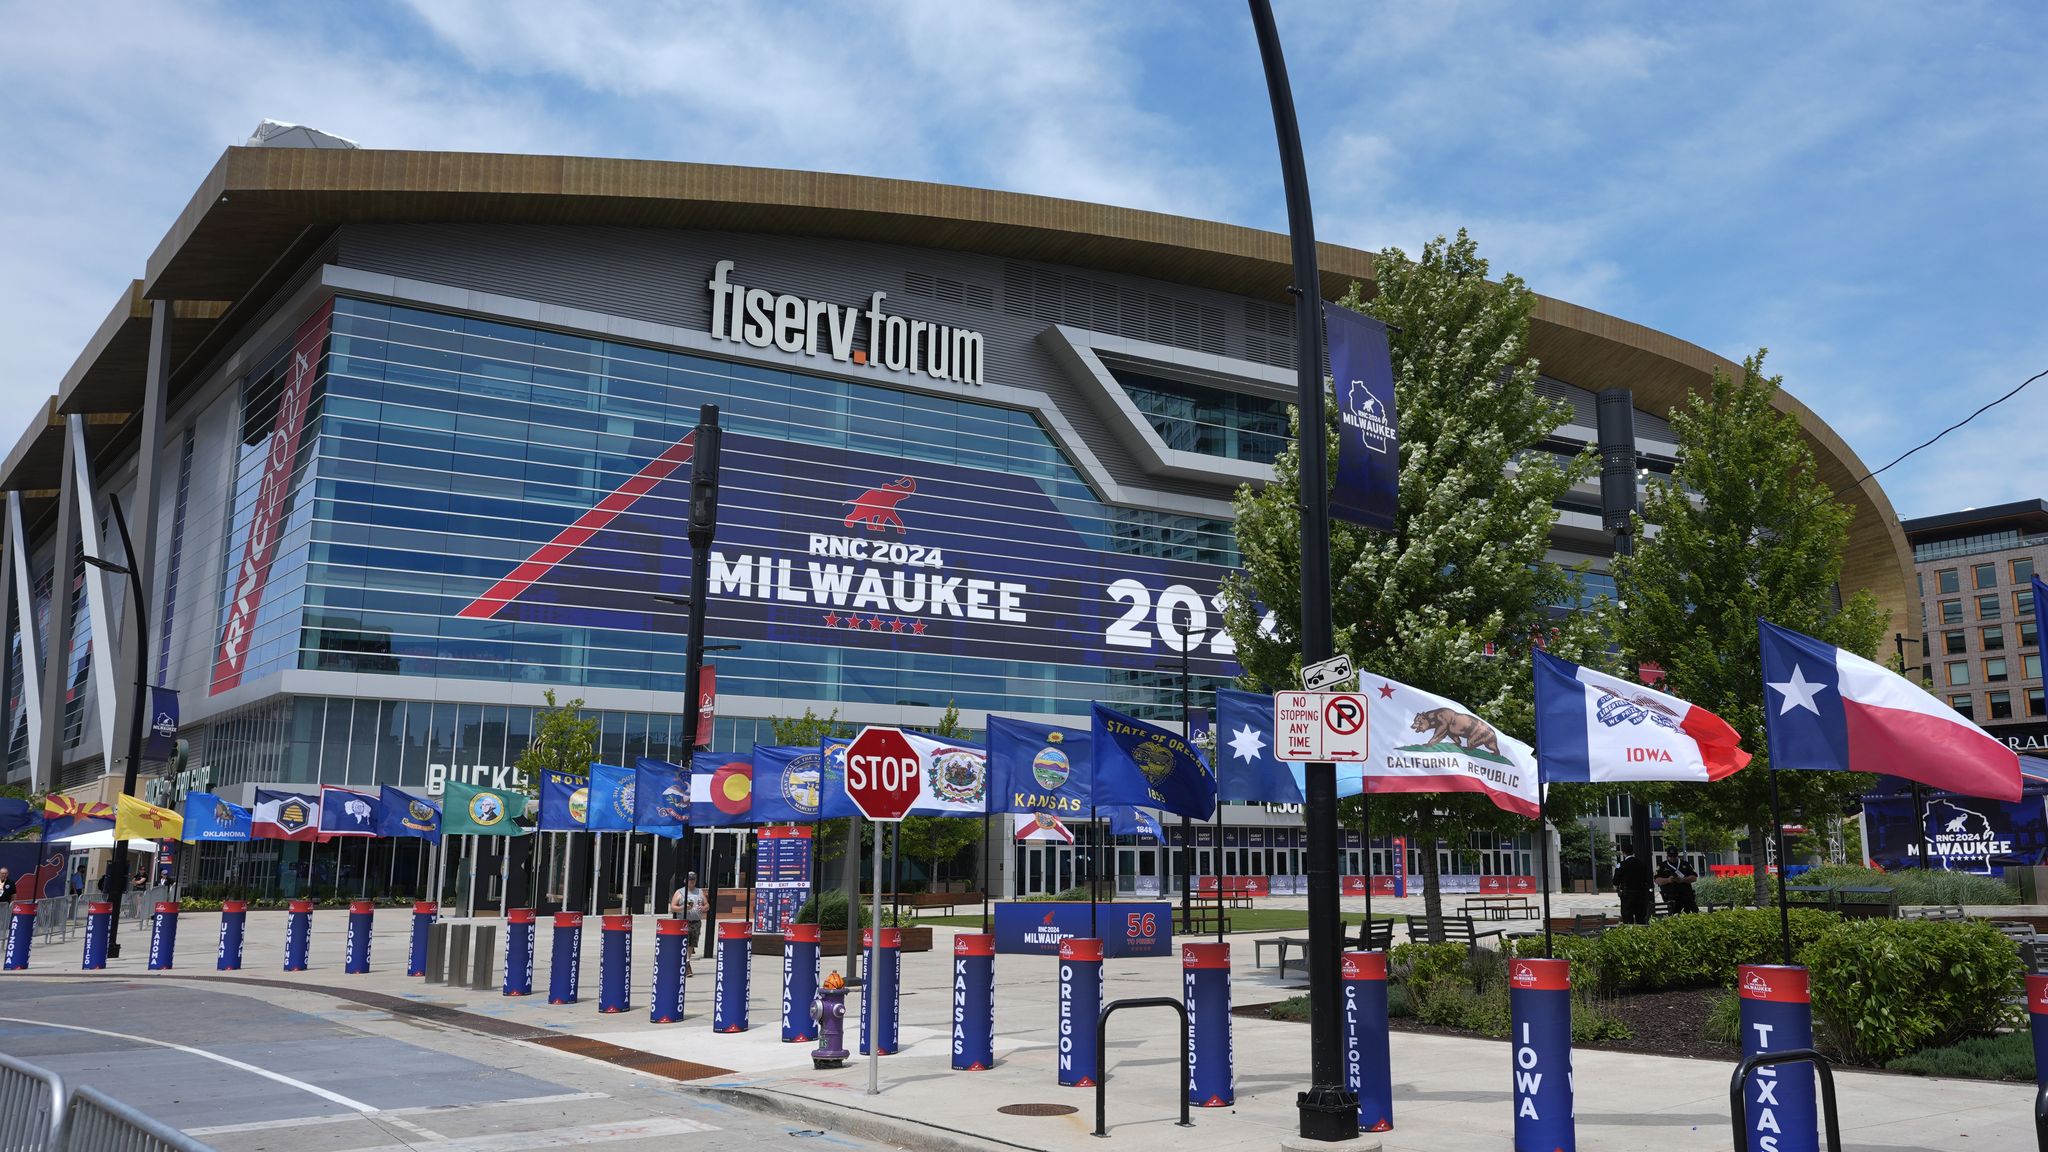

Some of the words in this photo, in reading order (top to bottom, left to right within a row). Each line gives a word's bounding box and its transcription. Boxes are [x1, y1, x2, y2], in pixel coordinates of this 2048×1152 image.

[866, 290, 984, 385] forum
[1343, 412, 1396, 440] MILWAUKEE
[809, 532, 869, 561] RNC
[871, 541, 944, 569] 2024
[709, 551, 1027, 623] MILWAUKEE
[1280, 709, 1319, 721] STOPPING
[1292, 696, 1306, 707] NO
[1608, 715, 1619, 725] WE
[1288, 736, 1310, 748] TIME
[1289, 723, 1309, 734] ANY
[1106, 720, 1147, 738] STATE
[1151, 735, 1166, 743] OF
[1168, 738, 1206, 777] OREGON
[1626, 747, 1673, 762] IOWA
[850, 755, 918, 792] STOP
[1386, 756, 1460, 769] CALIFORNIA
[1467, 762, 1519, 788] REPUBLIC
[1014, 792, 1081, 811] KANSAS
[203, 830, 246, 838] OKLAHOMA
[1907, 840, 2012, 856] MLWAUKEE
[1936, 833, 1956, 842] RNC
[1956, 833, 1980, 842] 2024
[5, 915, 18, 964] ARIZONA
[150, 914, 163, 965] OKLAHOMA
[218, 922, 227, 958] UTAH
[284, 913, 294, 966] WYOMING
[346, 922, 354, 963] IDAHO
[1126, 912, 1156, 938] 56
[84, 933, 92, 965] MEXICO
[525, 924, 535, 986] MONTANA
[569, 960, 577, 996] DAKOTA
[676, 937, 687, 1013] COLORADO
[715, 942, 724, 1022] NEBRASKA
[782, 944, 793, 1029] NEVADA
[954, 959, 966, 1055] KANSAS
[1060, 965, 1073, 1071] OREGON
[1186, 973, 1197, 1091] MINNESOTA
[1516, 1022, 1542, 1120] IOWA
